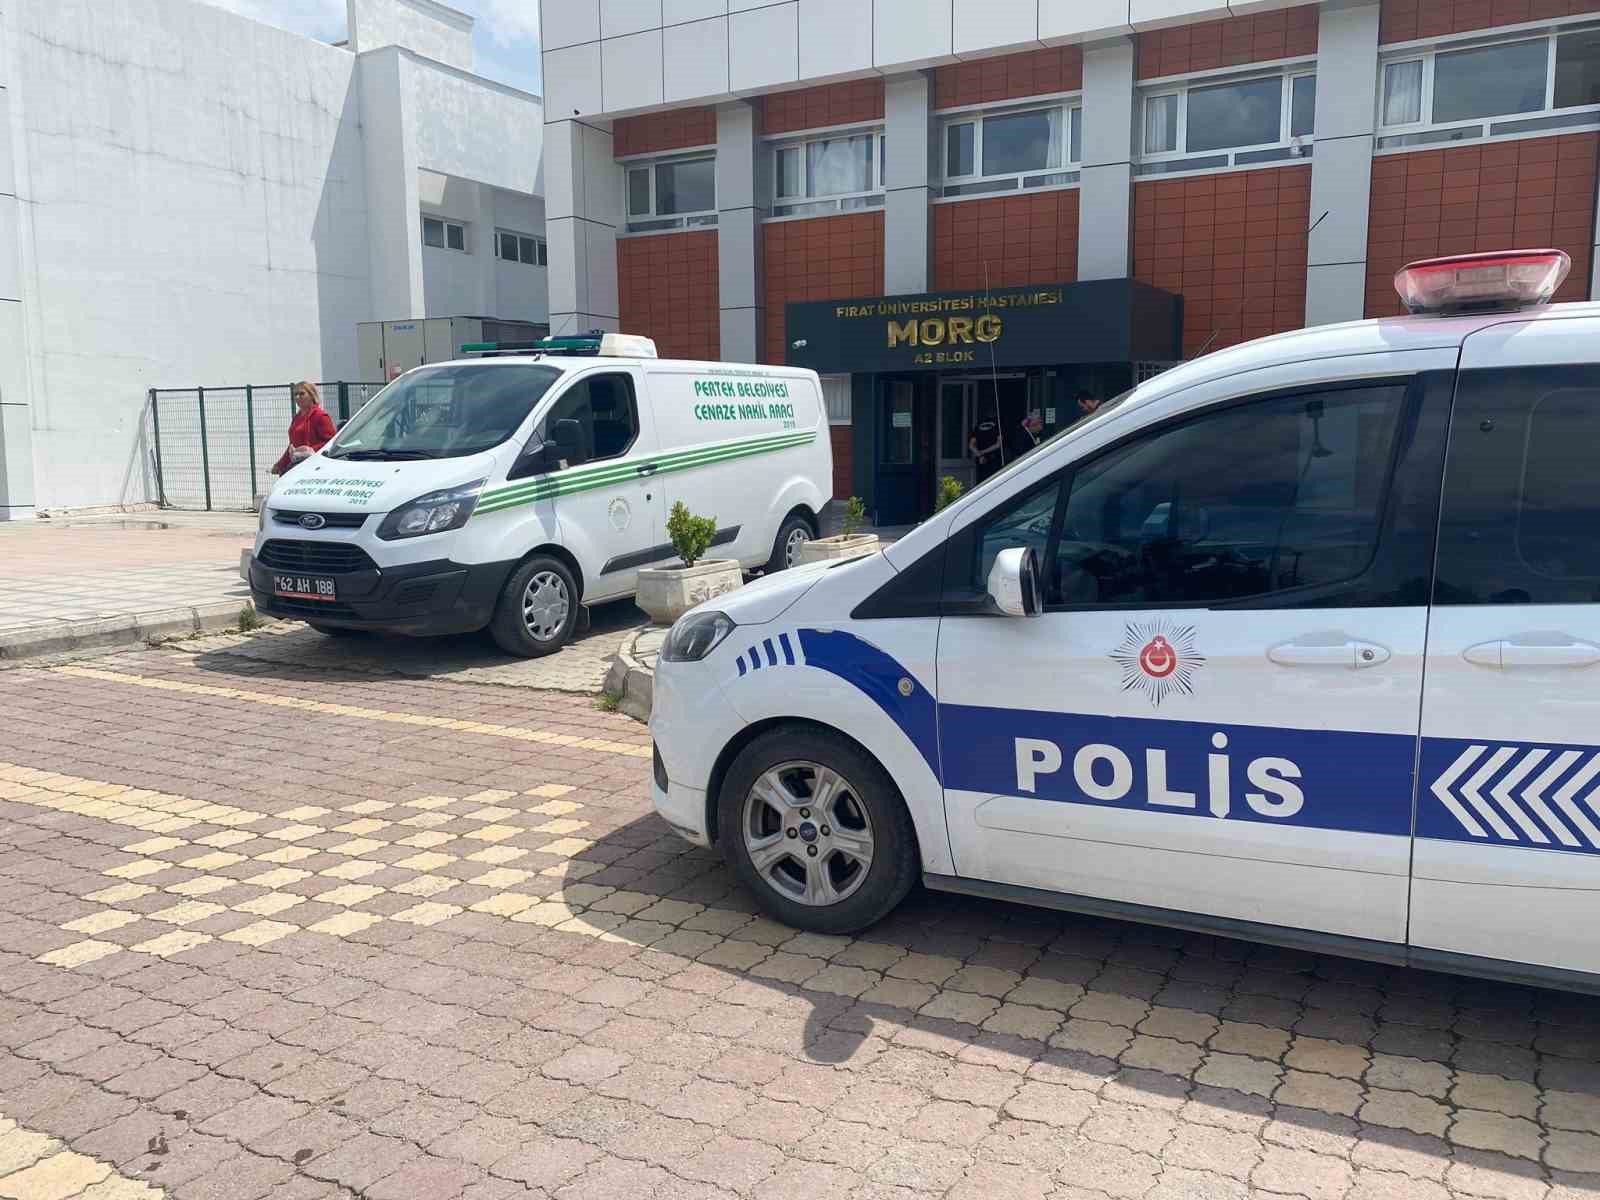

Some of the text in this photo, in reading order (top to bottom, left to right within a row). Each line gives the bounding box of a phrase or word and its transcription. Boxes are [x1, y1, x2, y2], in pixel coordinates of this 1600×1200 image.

[836, 288, 1063, 318] FIRAT ÜNİVERSİTESİ HASTANESİ
[887, 313, 1003, 348] MORG
[914, 350, 975, 365] A2 BLOK
[694, 379, 790, 398] PERTEK BELEDİYESİ
[694, 402, 795, 420] CENAZE NAKİL ARACI
[280, 577, 334, 595] 62 AH 188
[1015, 731, 1304, 818] POLİS
